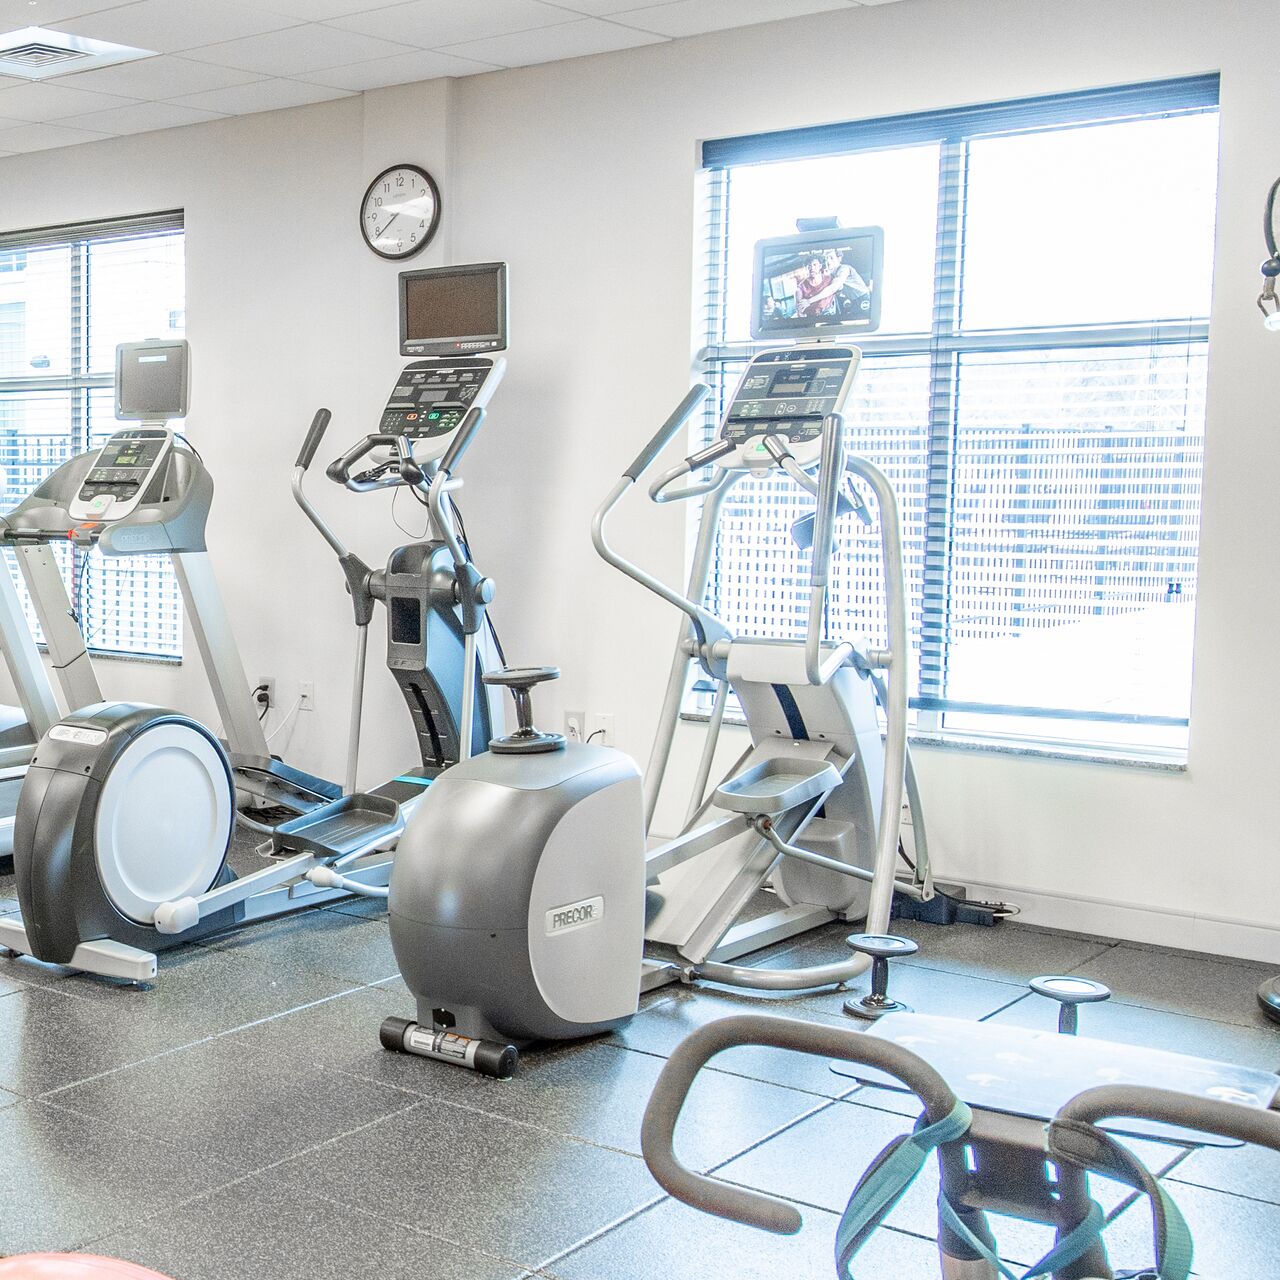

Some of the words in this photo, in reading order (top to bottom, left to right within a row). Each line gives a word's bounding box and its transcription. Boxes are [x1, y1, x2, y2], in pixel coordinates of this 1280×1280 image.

[395, 177, 405, 187] 12
[384, 183, 390, 193] 11
[374, 197, 383, 207] 10
[371, 213, 377, 222] 9
[419, 220, 425, 228] 4
[410, 233, 416, 242] 5
[553, 904, 593, 929] PRECOR
